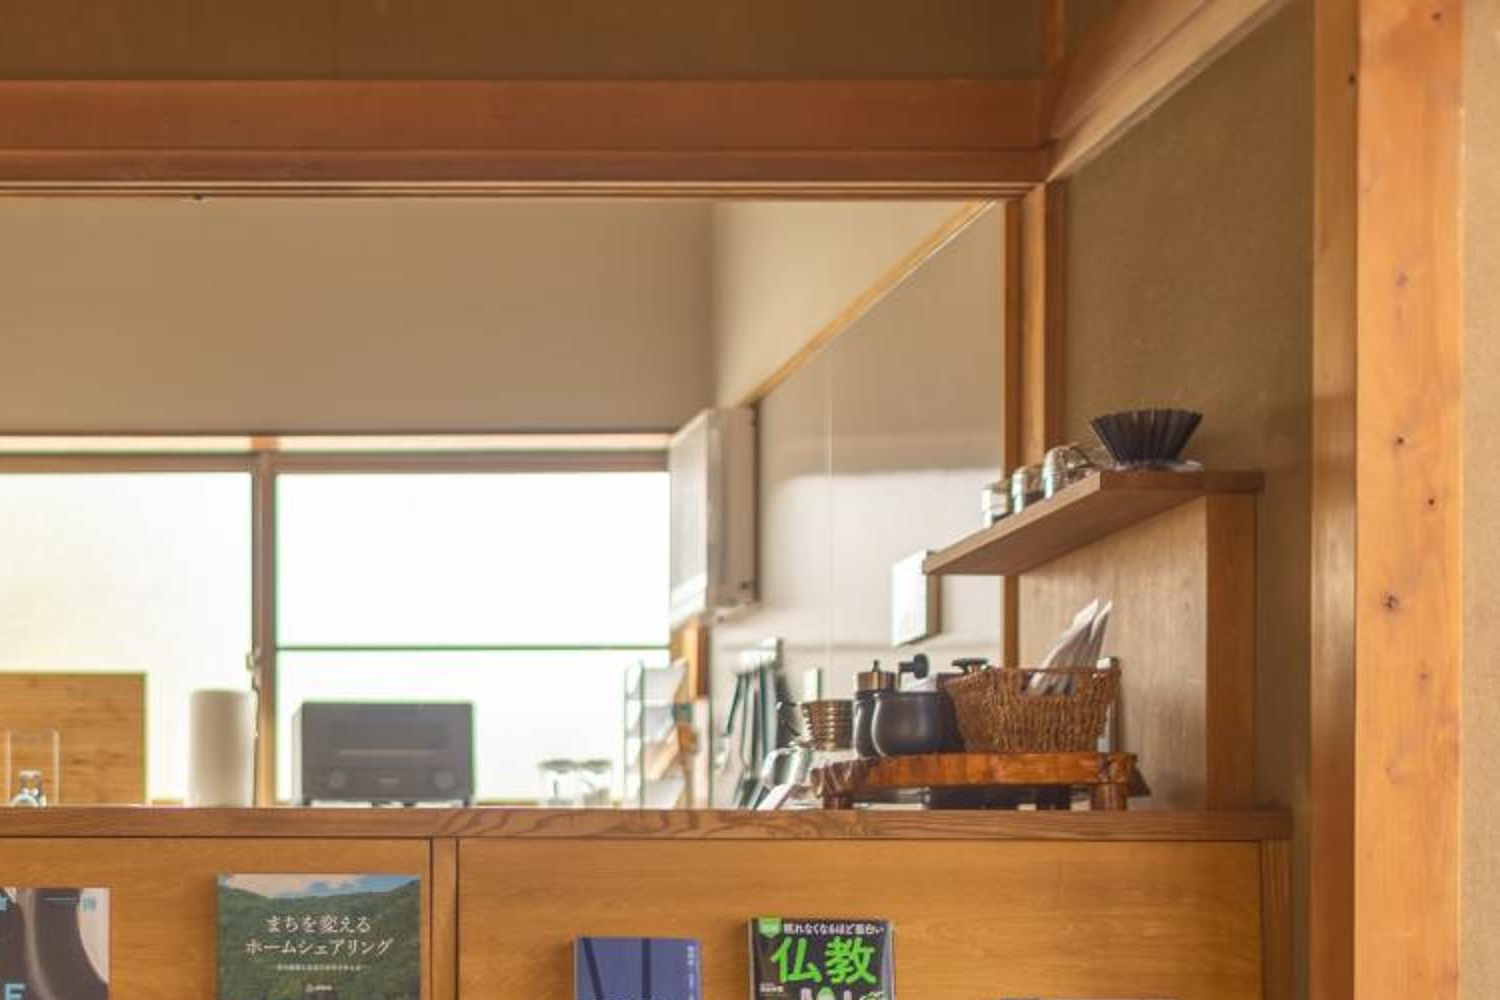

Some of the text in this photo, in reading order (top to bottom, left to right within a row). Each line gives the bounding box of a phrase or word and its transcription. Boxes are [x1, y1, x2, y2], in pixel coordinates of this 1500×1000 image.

[266, 915, 372, 933] まちを変える
[245, 938, 393, 955] ホームシェアリング
[771, 936, 877, 984] 仏教
